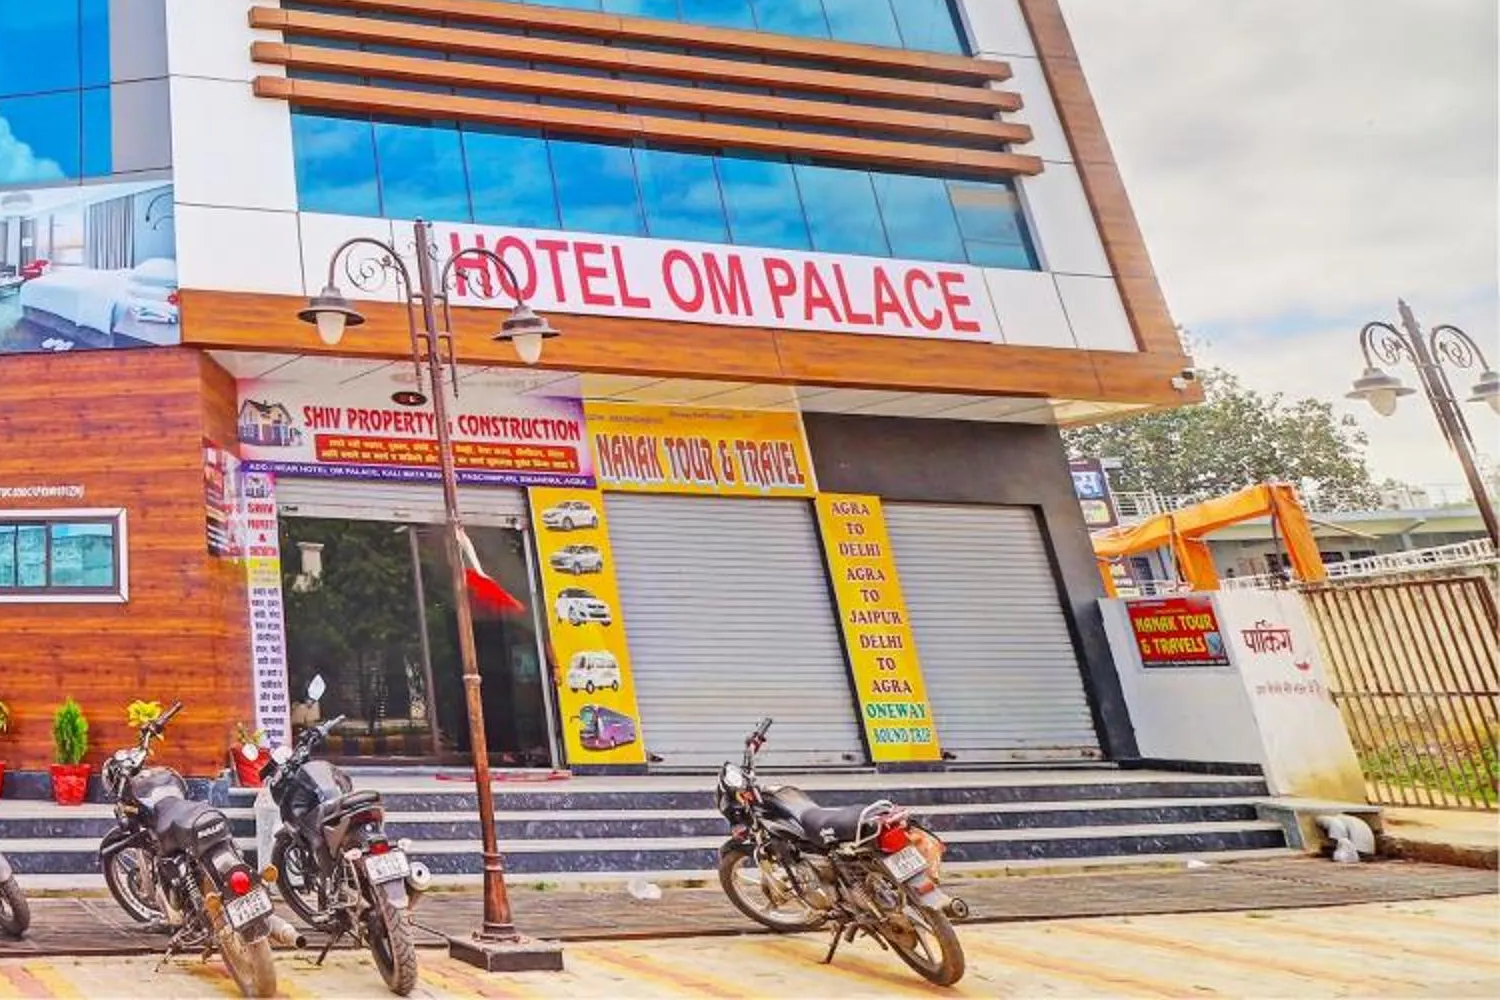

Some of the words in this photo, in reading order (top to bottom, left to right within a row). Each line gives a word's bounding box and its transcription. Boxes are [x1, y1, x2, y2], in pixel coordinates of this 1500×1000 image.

[449, 231, 651, 308] HOTEL
[661, 248, 753, 317] OM
[763, 256, 981, 333] PALACE
[303, 405, 341, 429] SHIV
[347, 408, 435, 435] PROPERTY
[457, 414, 581, 441] CONSTRUCTION
[664, 437, 718, 485] TOUR
[735, 438, 805, 487] TRAVEL
[831, 502, 870, 516] AGRA
[846, 523, 865, 536] TO
[839, 543, 881, 557] DELHI
[846, 567, 885, 582] AGRA
[860, 589, 880, 603] TO
[849, 610, 901, 625] JAIPUR
[1177, 613, 1215, 631] TOUR
[859, 635, 903, 649] DELHI
[1152, 636, 1207, 655] TRAVELS
[876, 657, 896, 671] TO
[872, 679, 913, 694] AGRA
[866, 703, 927, 719] ONEWAY
